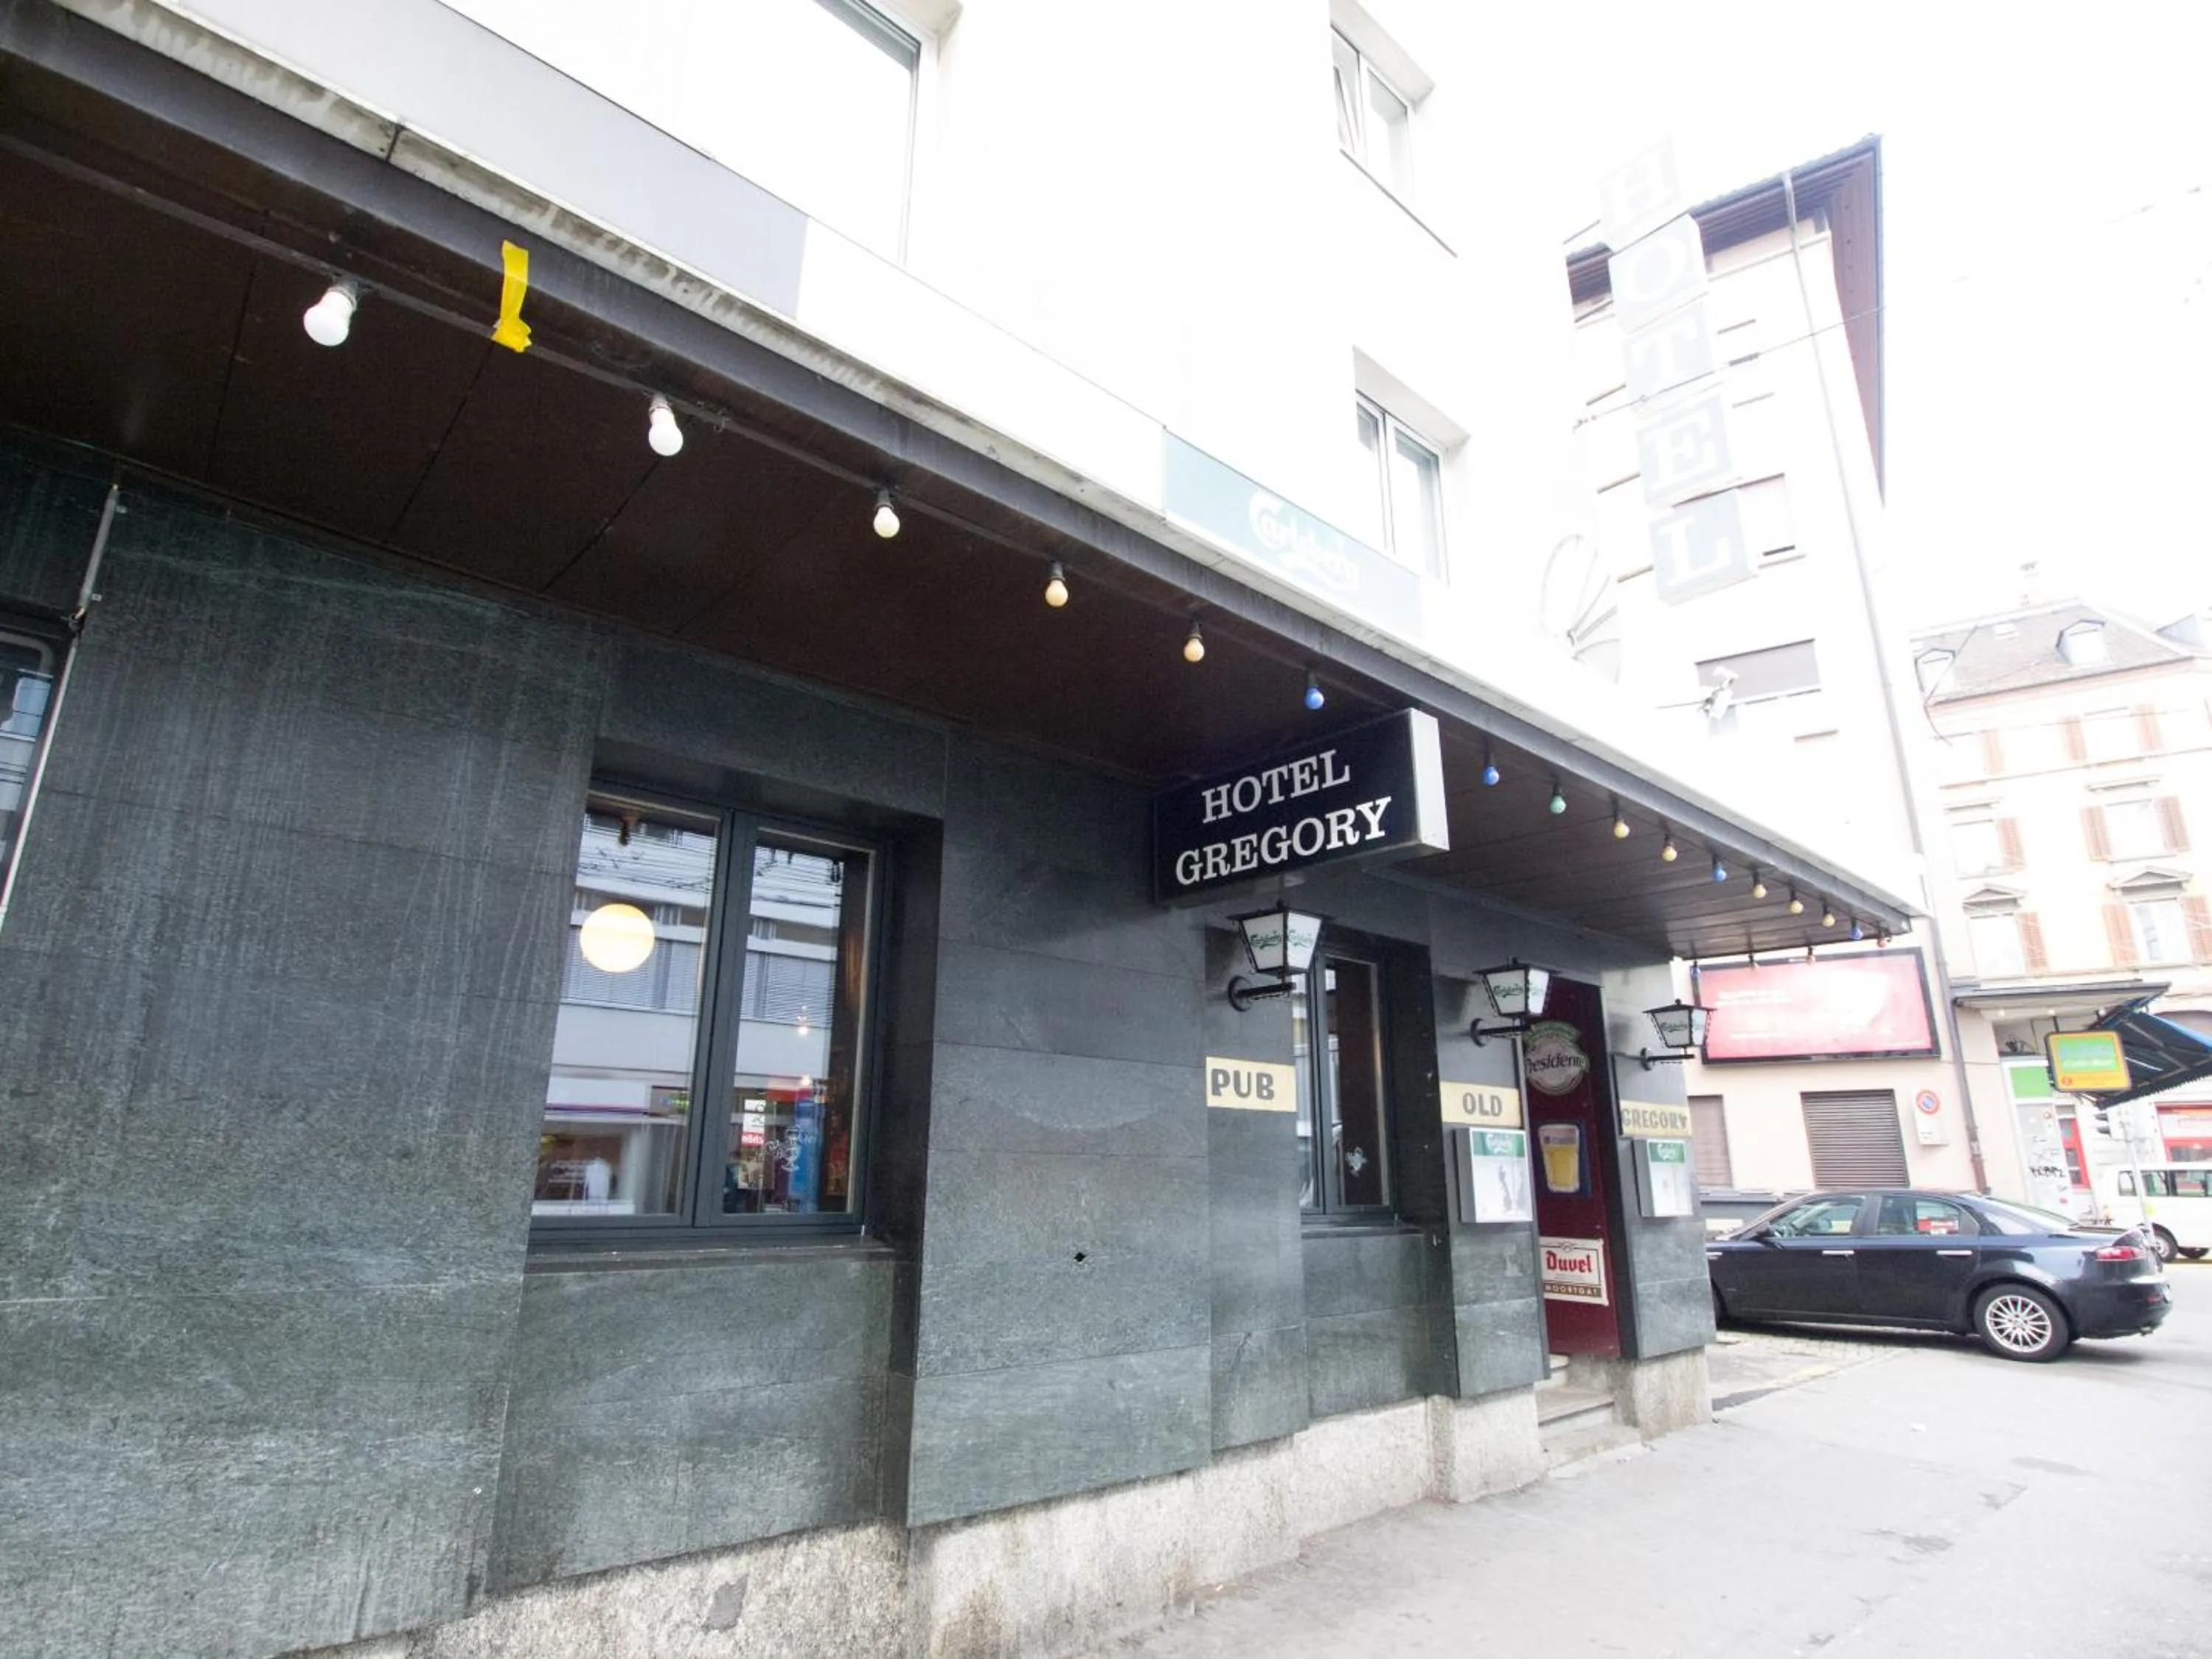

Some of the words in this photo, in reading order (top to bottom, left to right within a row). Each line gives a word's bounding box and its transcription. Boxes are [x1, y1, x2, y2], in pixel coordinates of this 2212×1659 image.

[1202, 750, 1350, 823] HOTEL
[1175, 797, 1391, 886] GREGORY
[1211, 1068, 1275, 1101] PUB
[1462, 1092, 1503, 1117] OLD
[1622, 1108, 1688, 1130] GREGORY
[1545, 1250, 1592, 1273] Duvel
